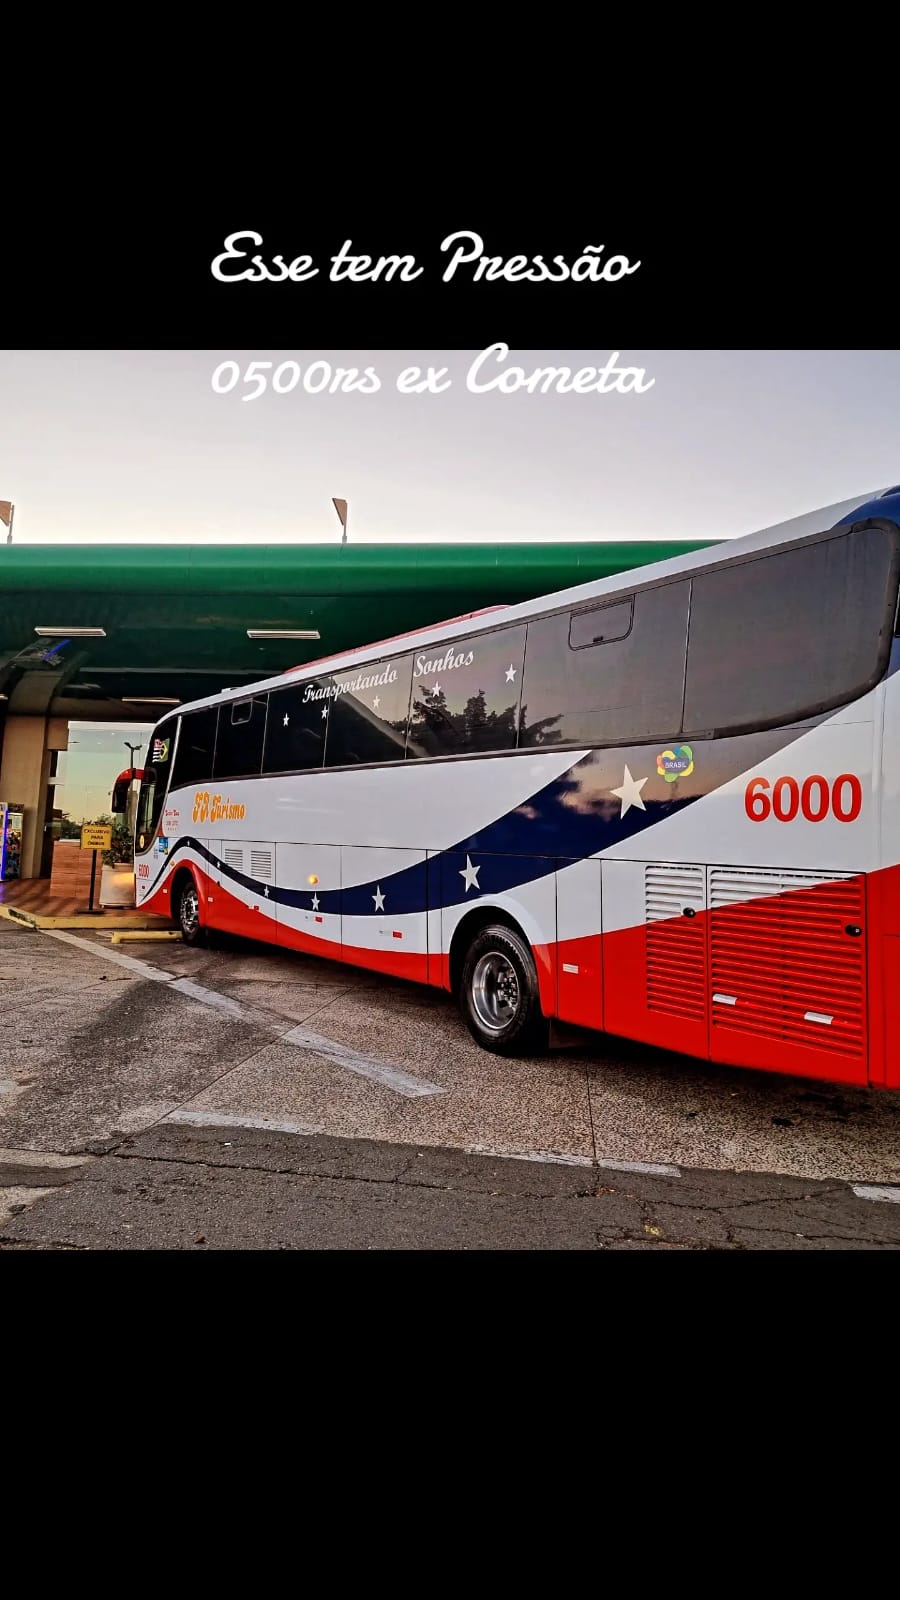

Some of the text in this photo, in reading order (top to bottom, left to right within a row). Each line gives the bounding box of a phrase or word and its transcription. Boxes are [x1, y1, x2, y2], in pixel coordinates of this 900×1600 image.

[302, 647, 474, 703] Transportando Sonhos
[210, 794, 246, 823] Turismo
[744, 773, 862, 823] 6000
